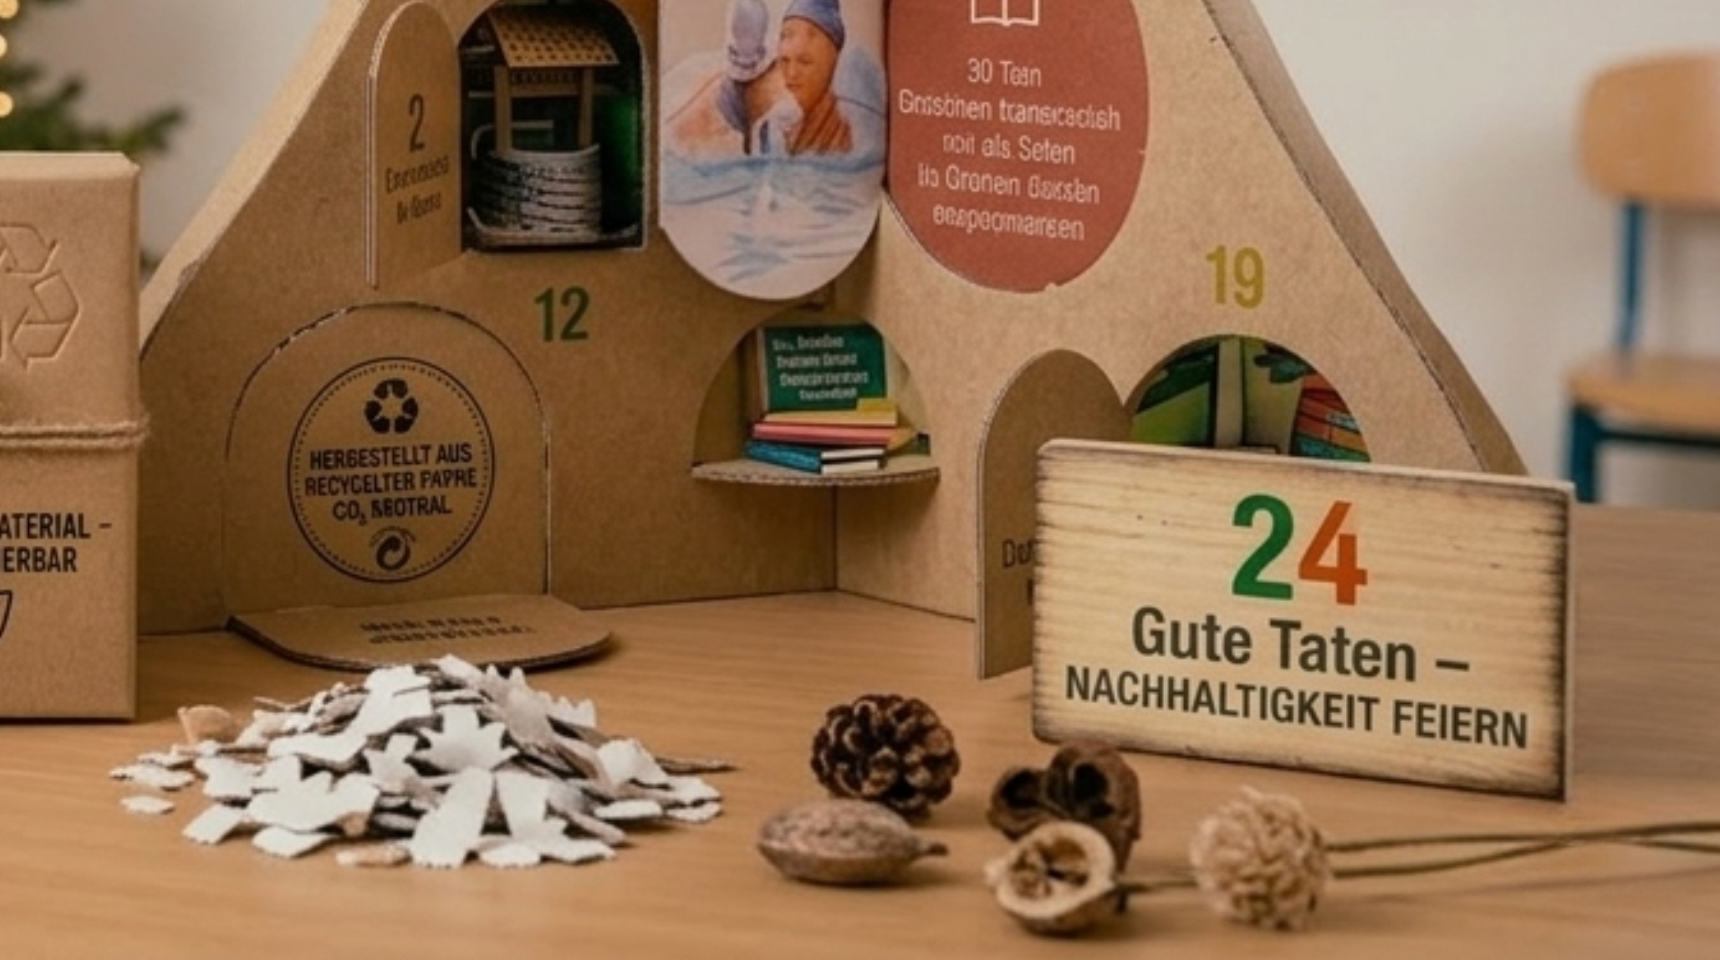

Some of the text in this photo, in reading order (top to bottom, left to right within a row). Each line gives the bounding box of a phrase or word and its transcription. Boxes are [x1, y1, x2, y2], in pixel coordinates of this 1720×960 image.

[967, 58, 993, 83] 30
[409, 94, 425, 153] 2
[1206, 245, 1265, 310] 19
[535, 286, 590, 342] 12
[436, 442, 473, 464] AUS
[1231, 493, 1368, 606] 24
[1131, 606, 1252, 665] Gute
[1269, 617, 1417, 683] Taten
[1065, 665, 1528, 750] NACHHALTIGKEIT FEIERN
